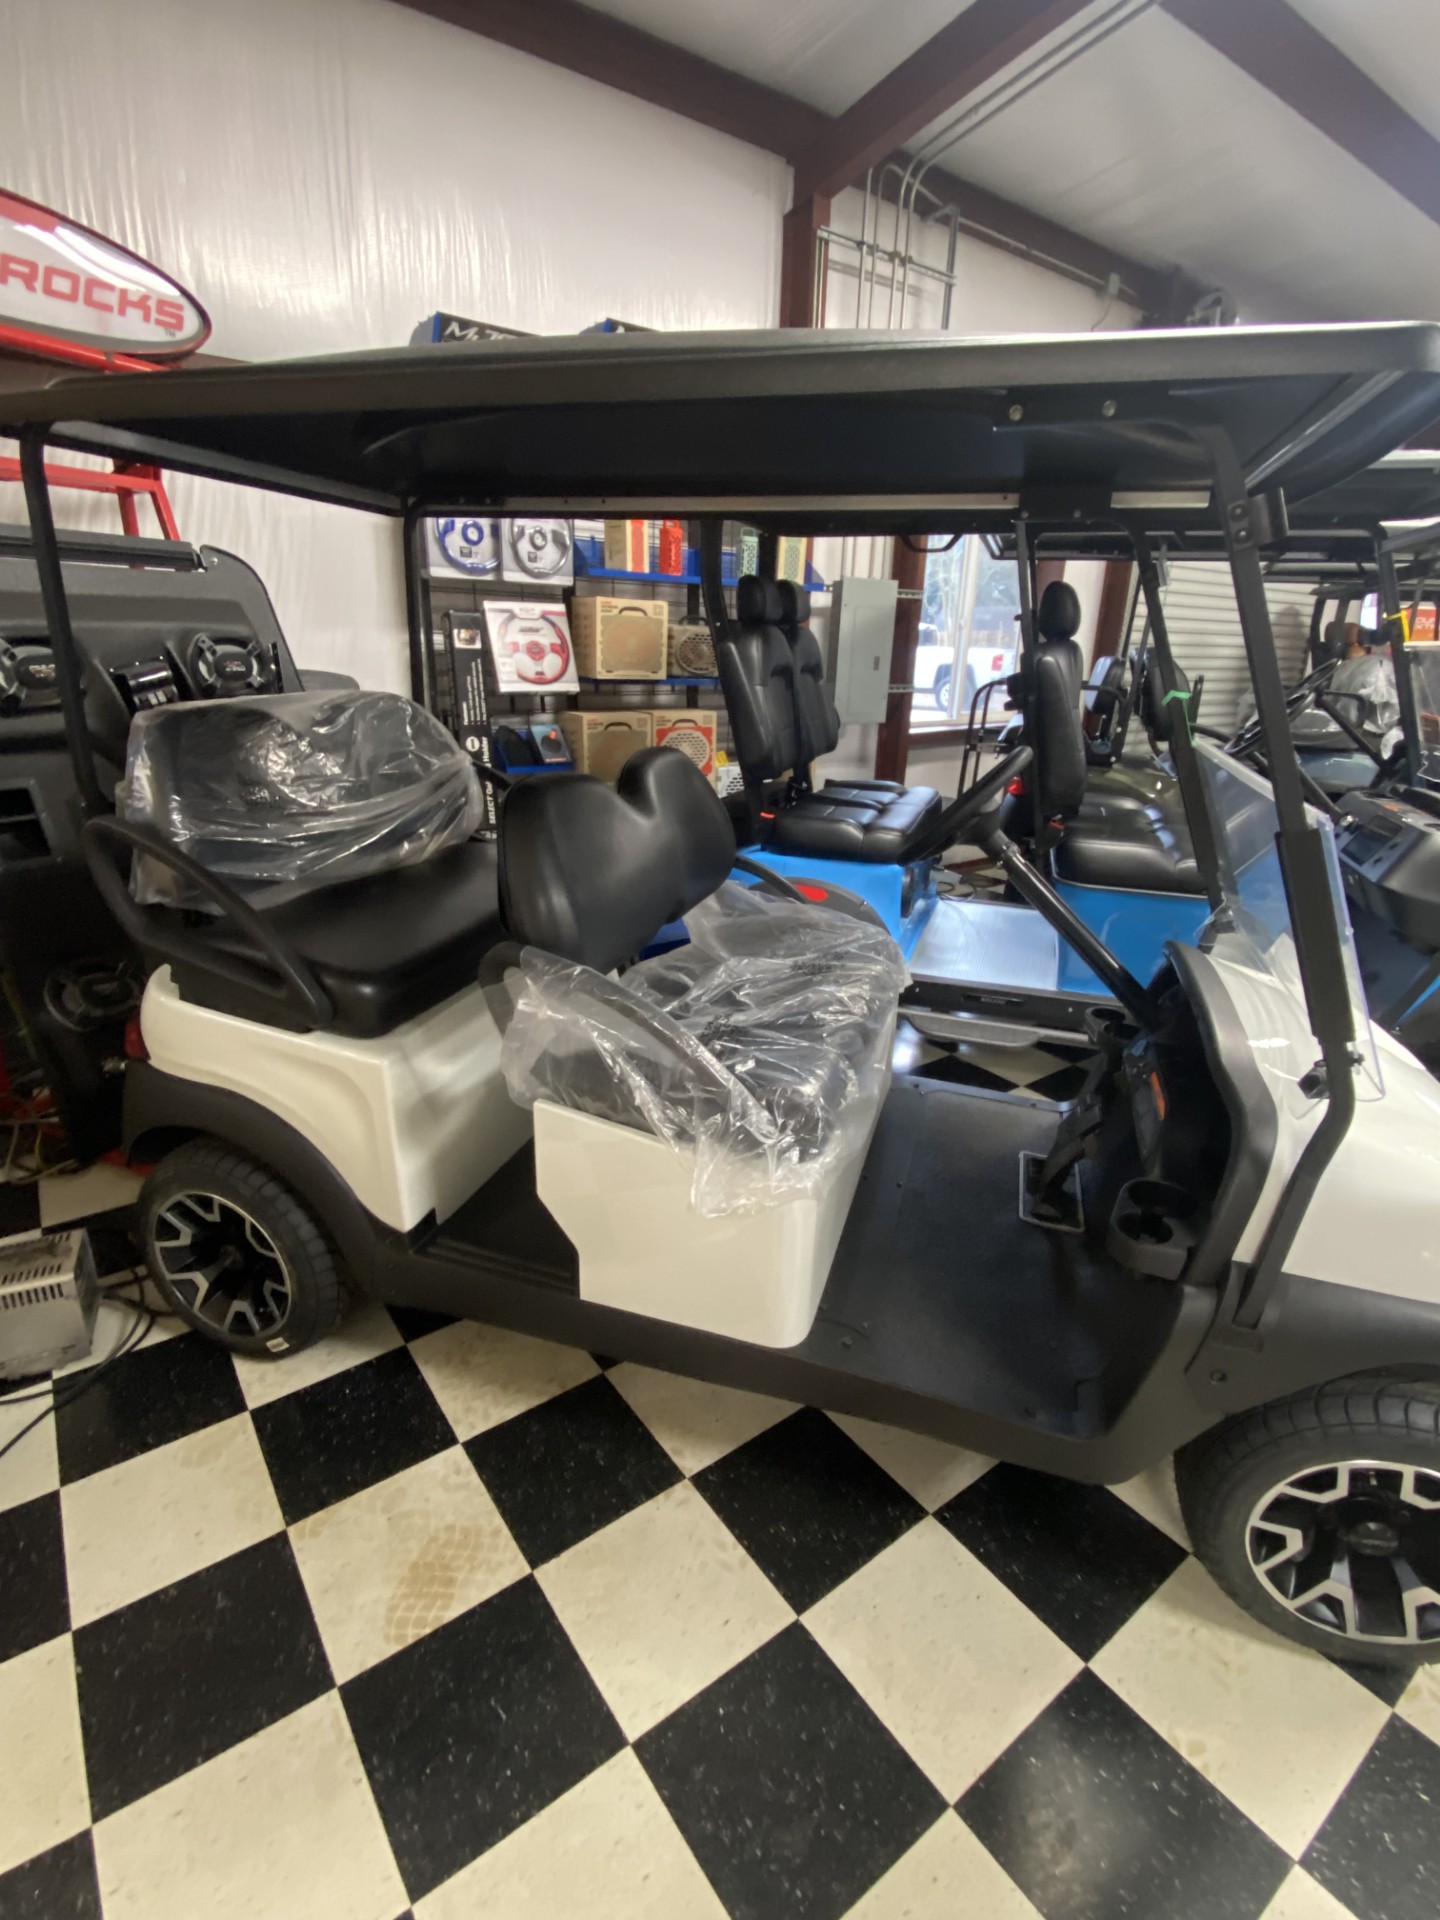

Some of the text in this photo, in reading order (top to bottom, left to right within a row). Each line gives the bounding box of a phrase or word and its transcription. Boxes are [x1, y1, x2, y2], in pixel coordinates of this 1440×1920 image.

[0, 253, 184, 332] ROCKS
[481, 736, 490, 762] Holder
[485, 781, 493, 795] Gol
[487, 795, 496, 825] SELECT
